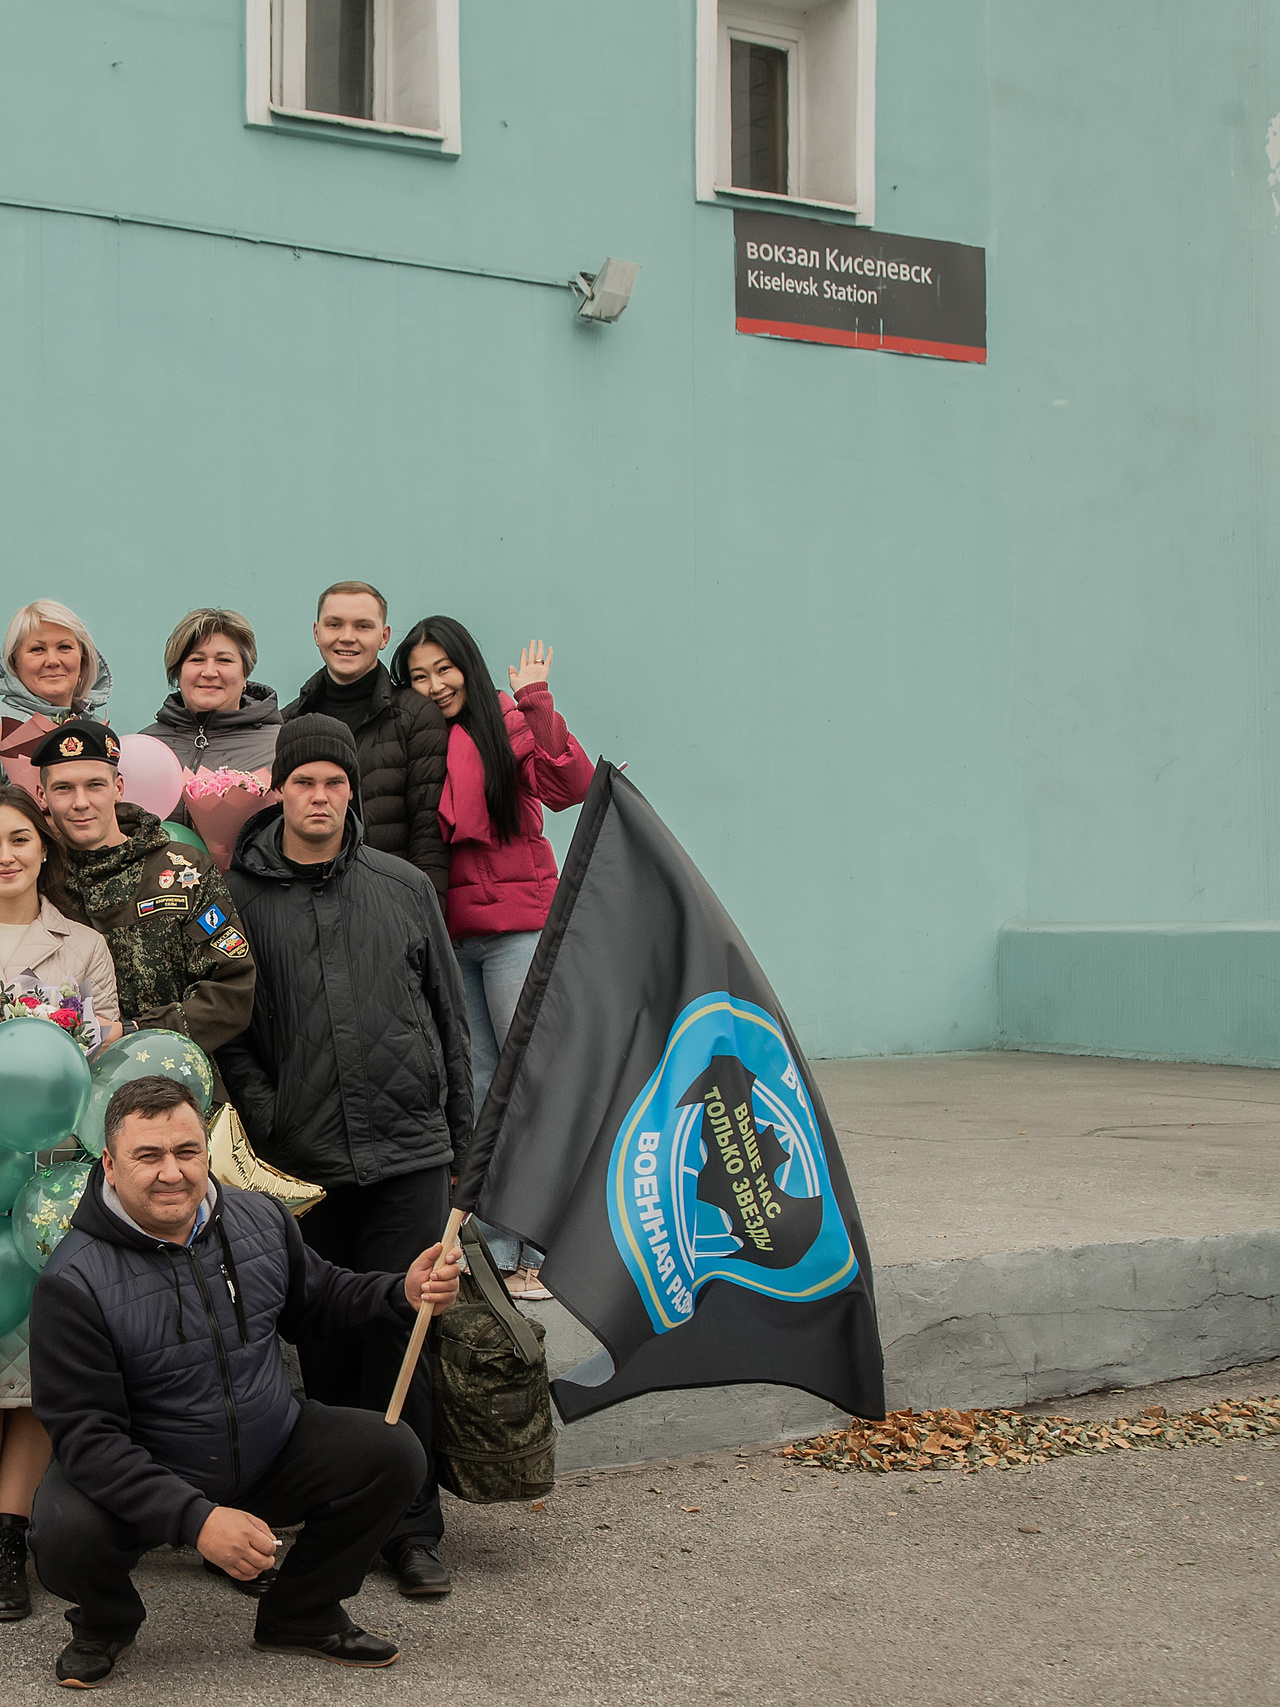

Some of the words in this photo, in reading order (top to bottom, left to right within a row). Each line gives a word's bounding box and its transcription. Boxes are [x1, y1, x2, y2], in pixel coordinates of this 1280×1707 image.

[746, 241, 820, 269] вокзал
[825, 247, 933, 285] Киселевск
[747, 269, 819, 297] Kiselevsk
[823, 280, 878, 305] Station
[633, 1131, 676, 1283] ВОЕННАЯ
[704, 1085, 744, 1175] ТОЛЬКО
[732, 1177, 774, 1252] ЗВЕЗДЫ
[733, 1102, 763, 1174] ВЫШЕ
[755, 1172, 782, 1219] НАС
